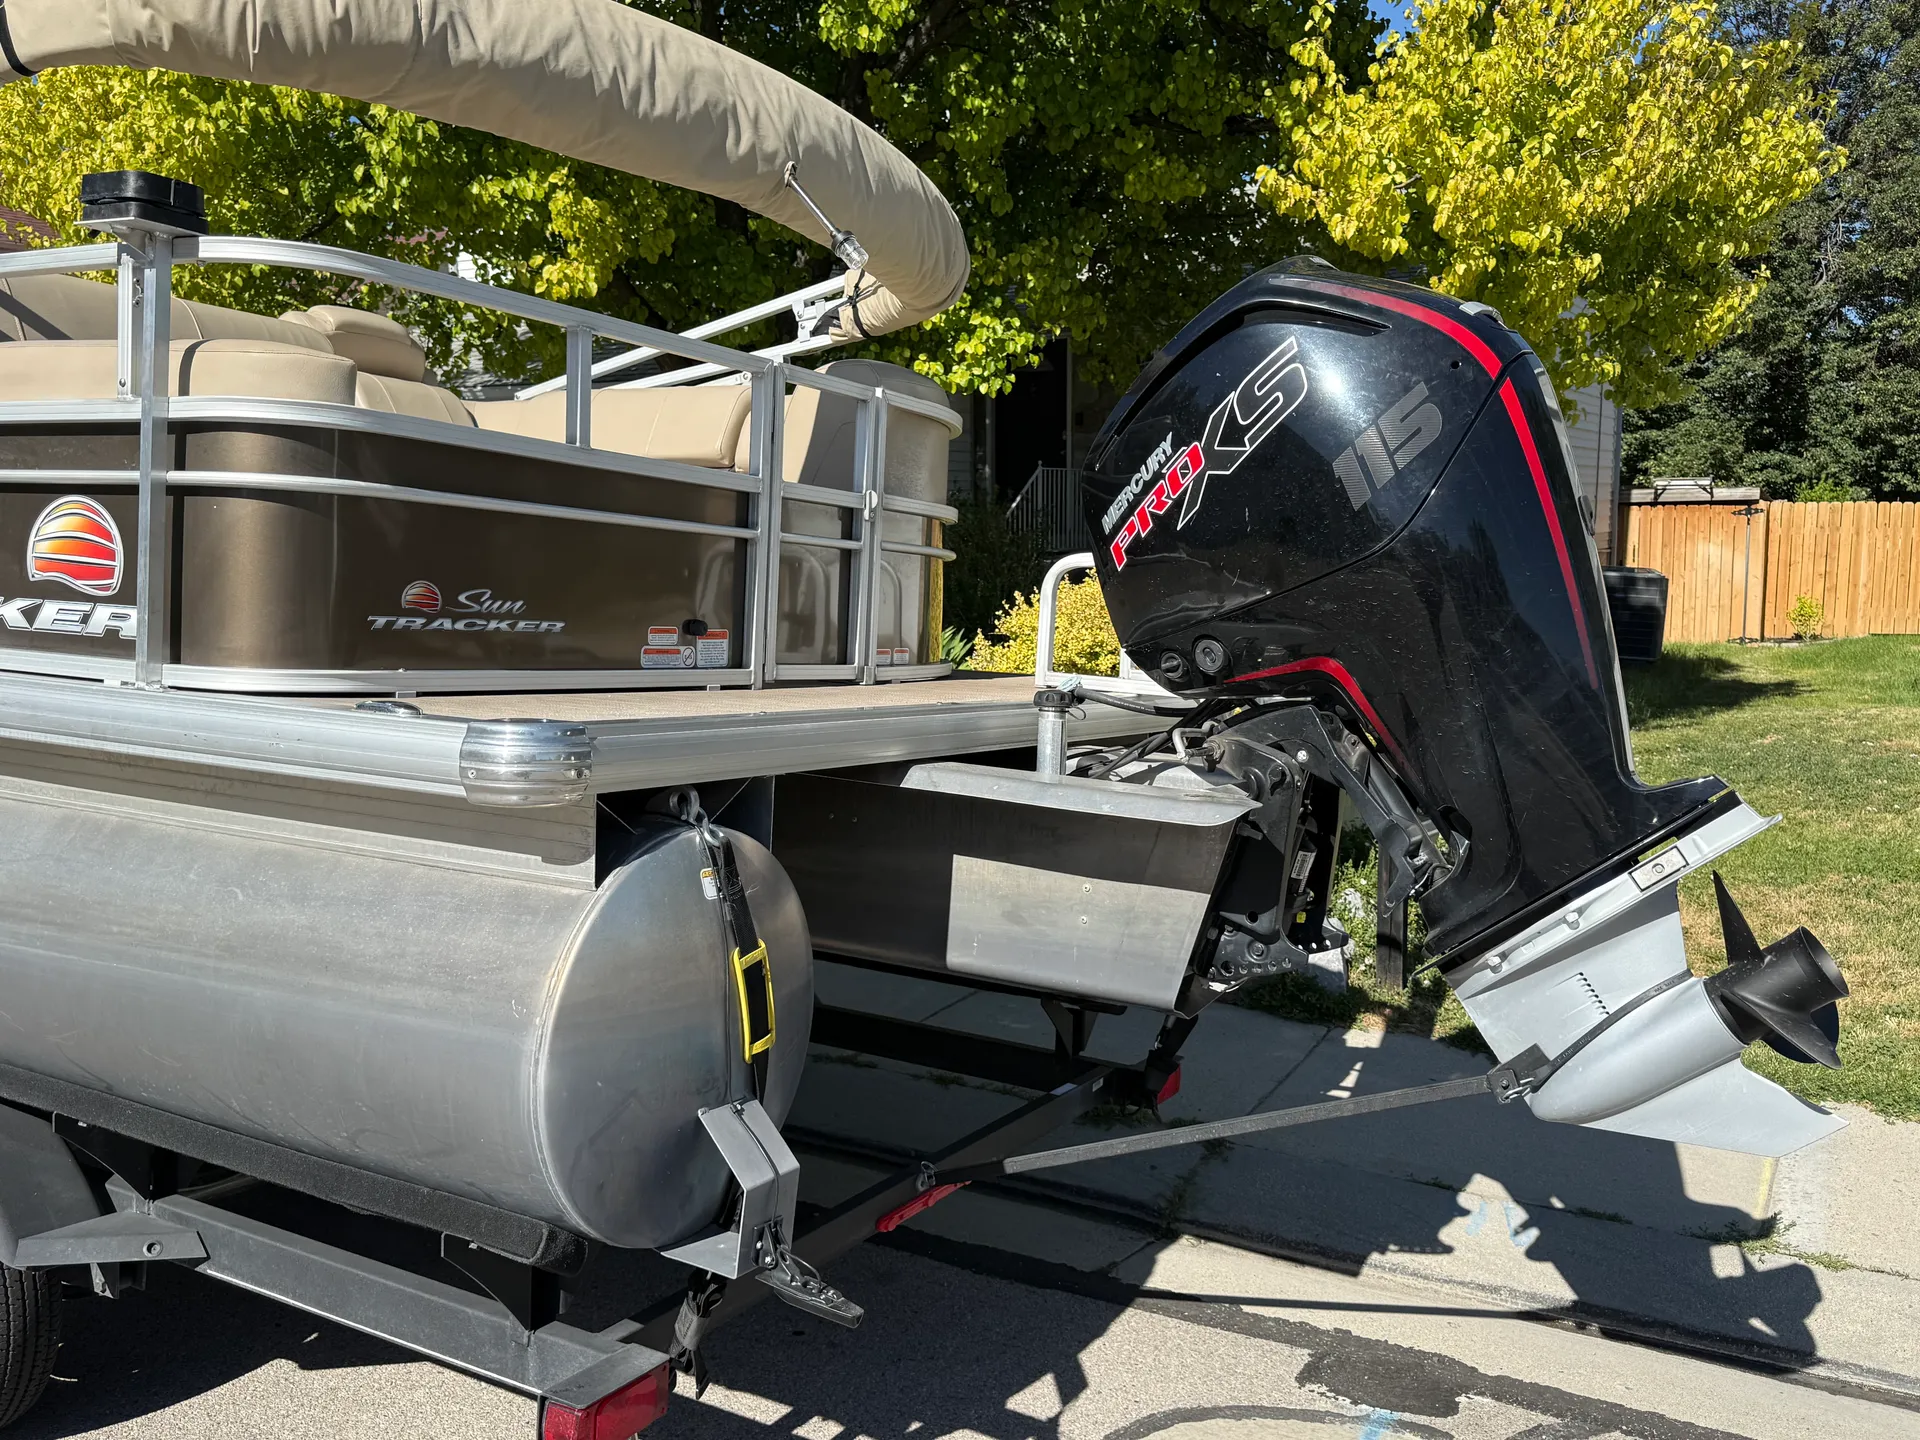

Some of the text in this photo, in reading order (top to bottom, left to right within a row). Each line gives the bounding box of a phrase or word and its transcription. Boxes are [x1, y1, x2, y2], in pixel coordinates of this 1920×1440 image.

[1332, 381, 1443, 512] 115
[1101, 431, 1173, 535] MERCURY
[367, 615, 566, 633] TRACKER
[446, 588, 527, 614] Sun
